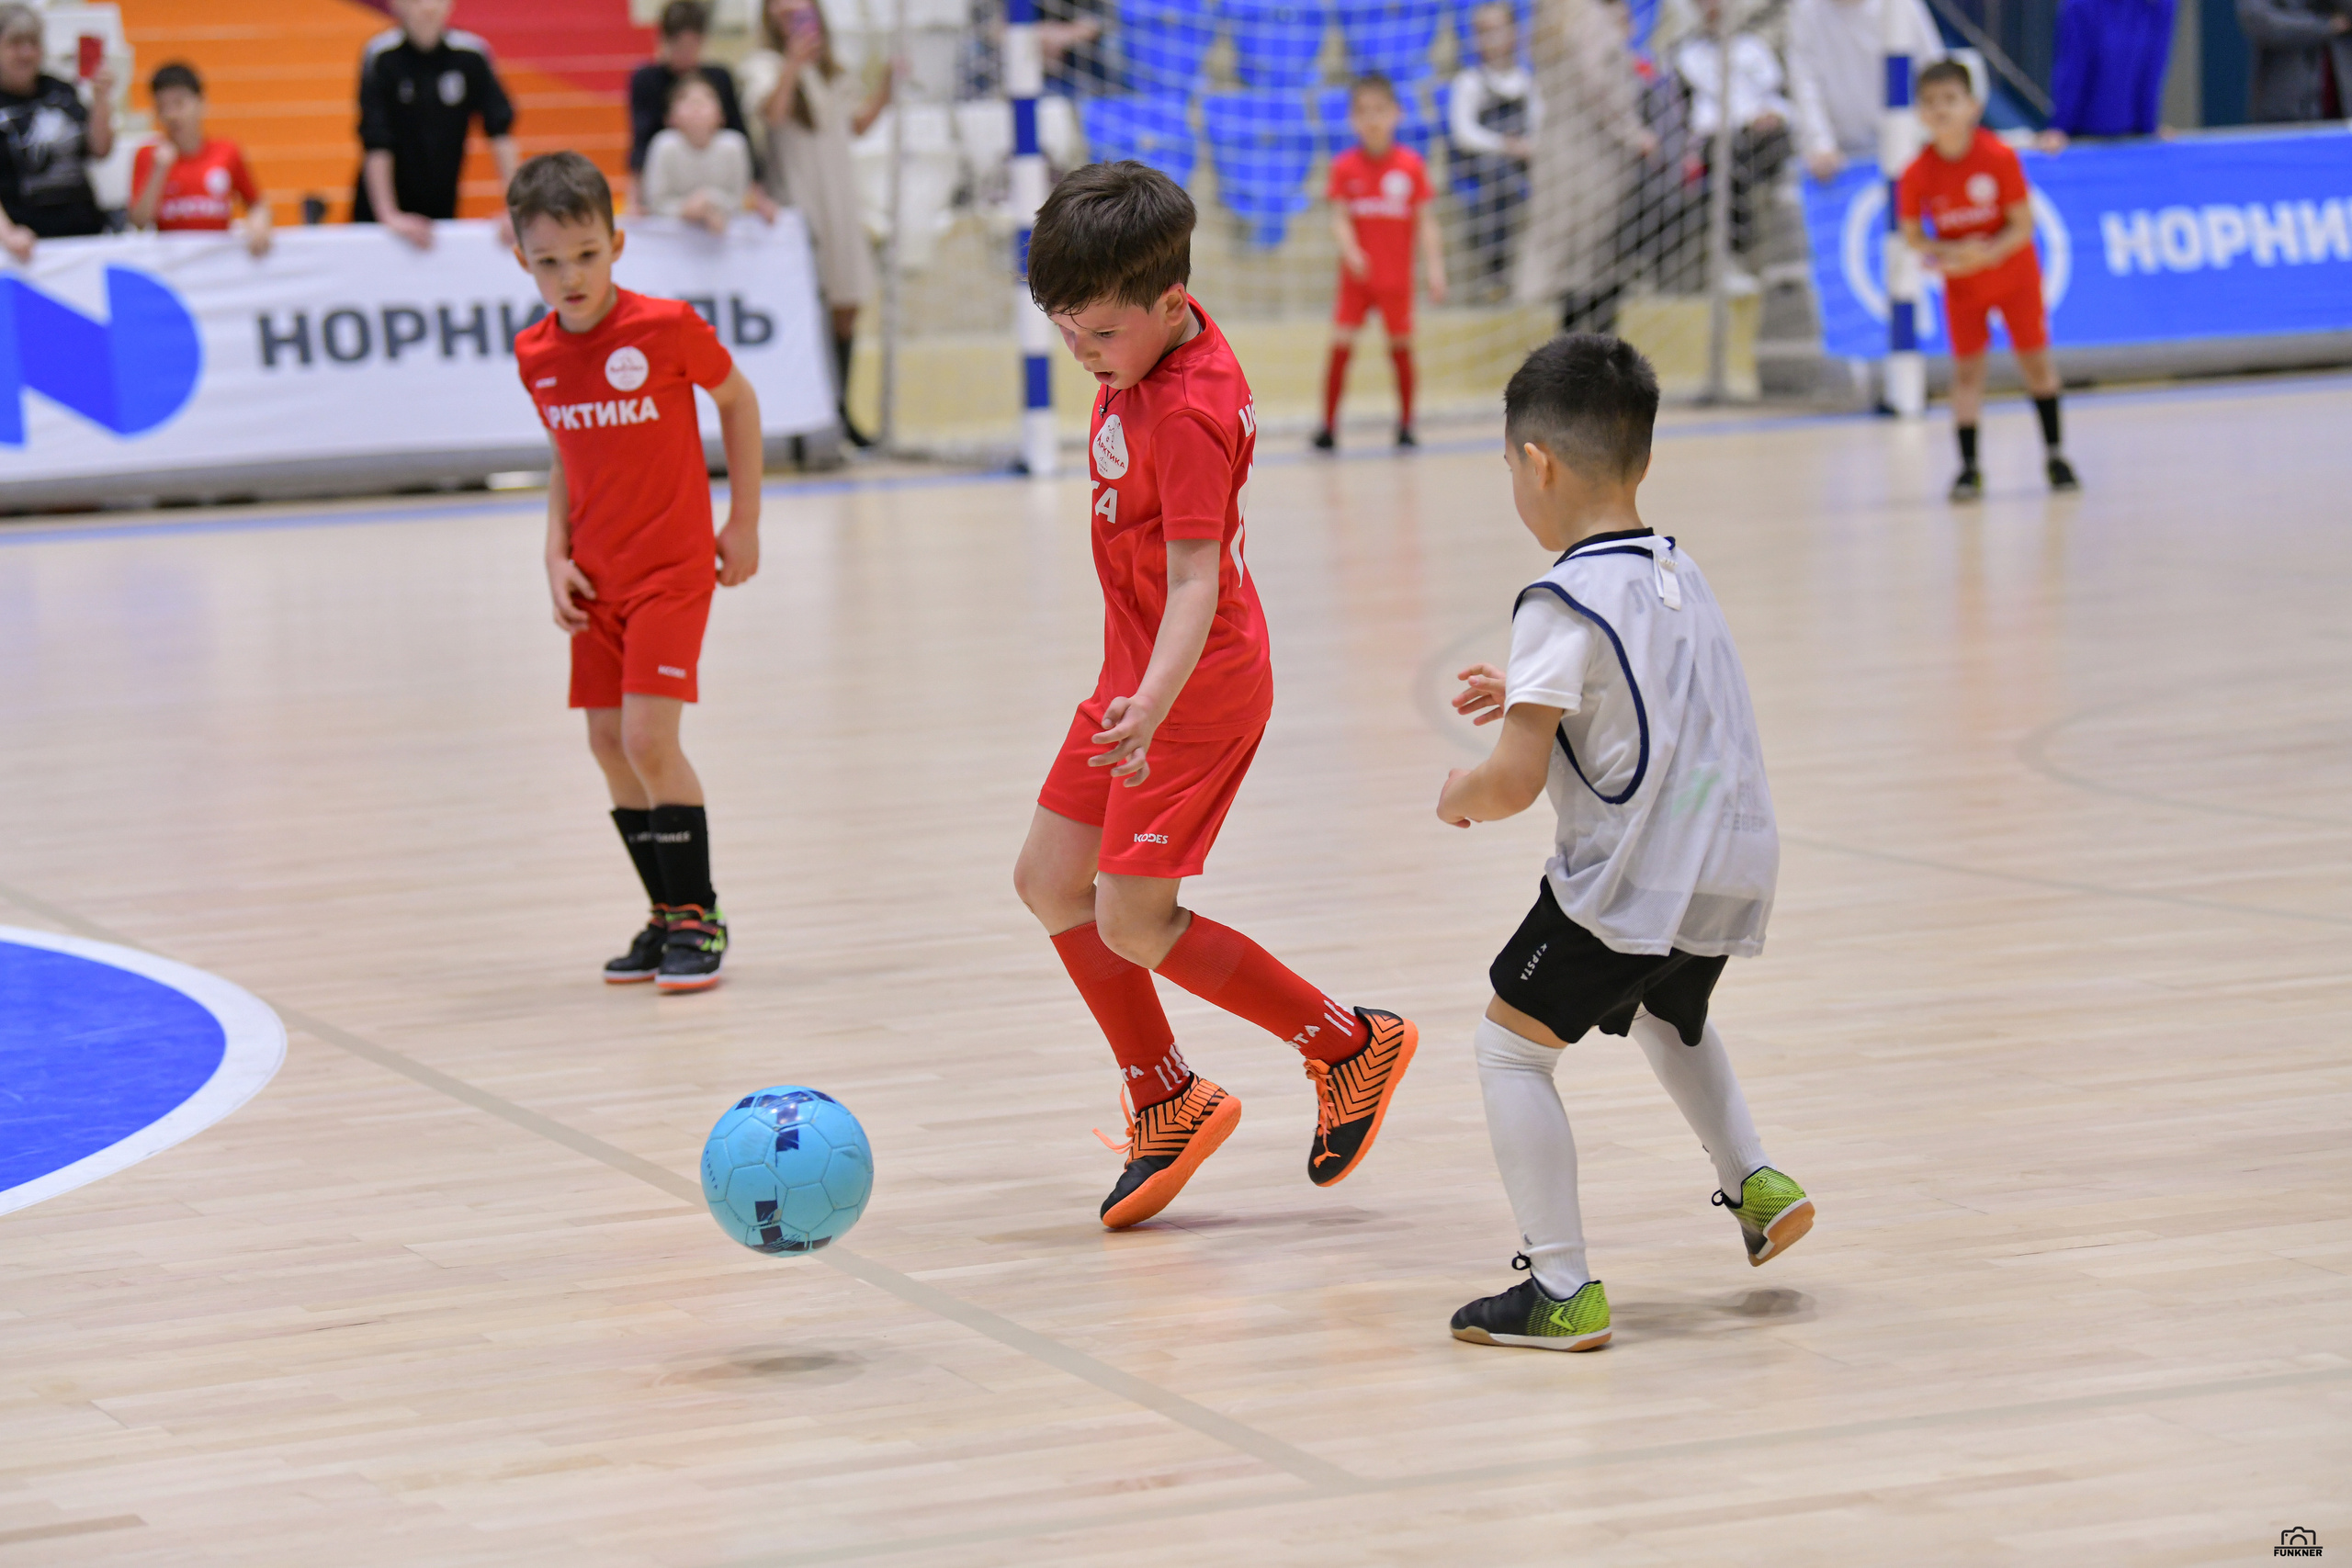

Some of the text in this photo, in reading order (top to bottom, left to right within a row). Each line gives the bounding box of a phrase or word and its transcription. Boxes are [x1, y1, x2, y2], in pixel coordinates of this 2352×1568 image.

[2100, 198, 2352, 276] НОРНИ
[258, 296, 775, 366] НОРНИЬ
[1097, 434, 1125, 469] АРКТИКА
[1134, 833, 1169, 844] KODES
[1520, 942, 1547, 980] KIPSTA
[1172, 1077, 1222, 1131] PUMA
